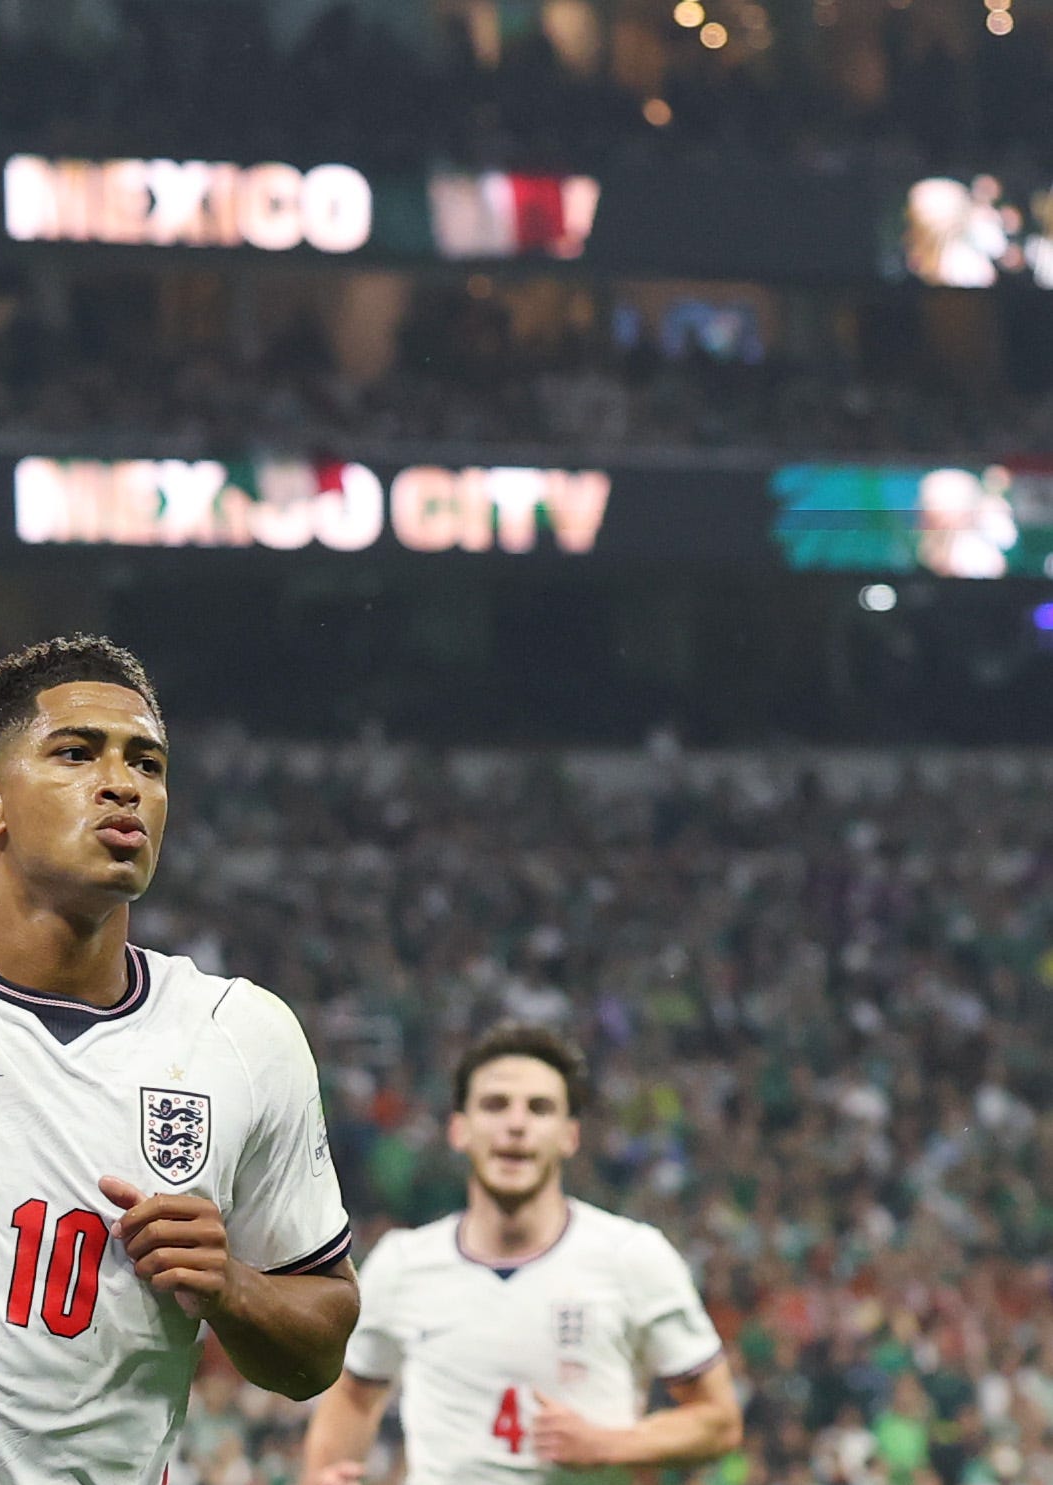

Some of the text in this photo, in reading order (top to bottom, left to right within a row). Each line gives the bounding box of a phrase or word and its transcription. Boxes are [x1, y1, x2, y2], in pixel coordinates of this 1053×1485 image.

[4, 154, 372, 253] MEXICO
[390, 465, 610, 553] CITY
[5, 1198, 107, 1338] 10
[492, 1387, 525, 1455] 4
